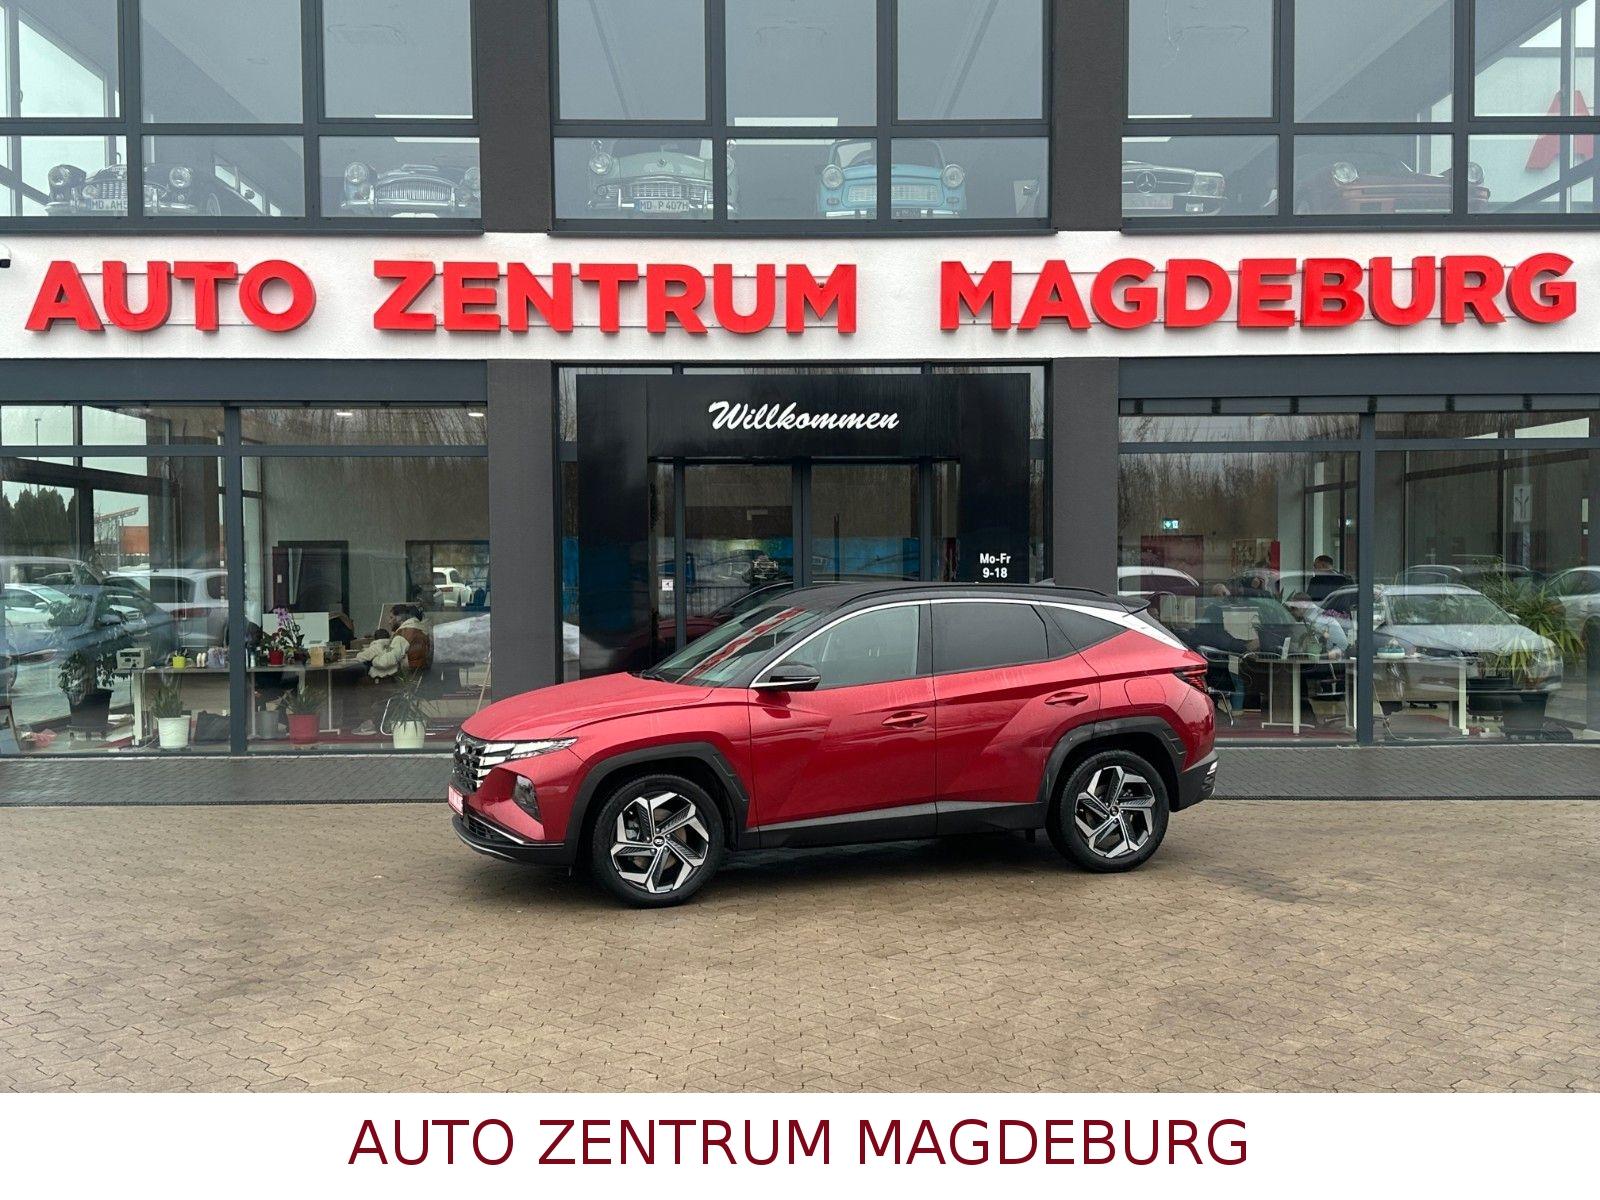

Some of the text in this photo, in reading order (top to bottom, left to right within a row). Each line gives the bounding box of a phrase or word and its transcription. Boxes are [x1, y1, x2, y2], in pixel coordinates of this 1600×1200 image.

[640, 201, 652, 210] MD
[26, 252, 1577, 335] AUTO ZENTRUM MAGDEBURG
[708, 400, 900, 431] Willkommen
[979, 552, 1012, 564] Mo-Fr
[982, 567, 1008, 579] 9-18
